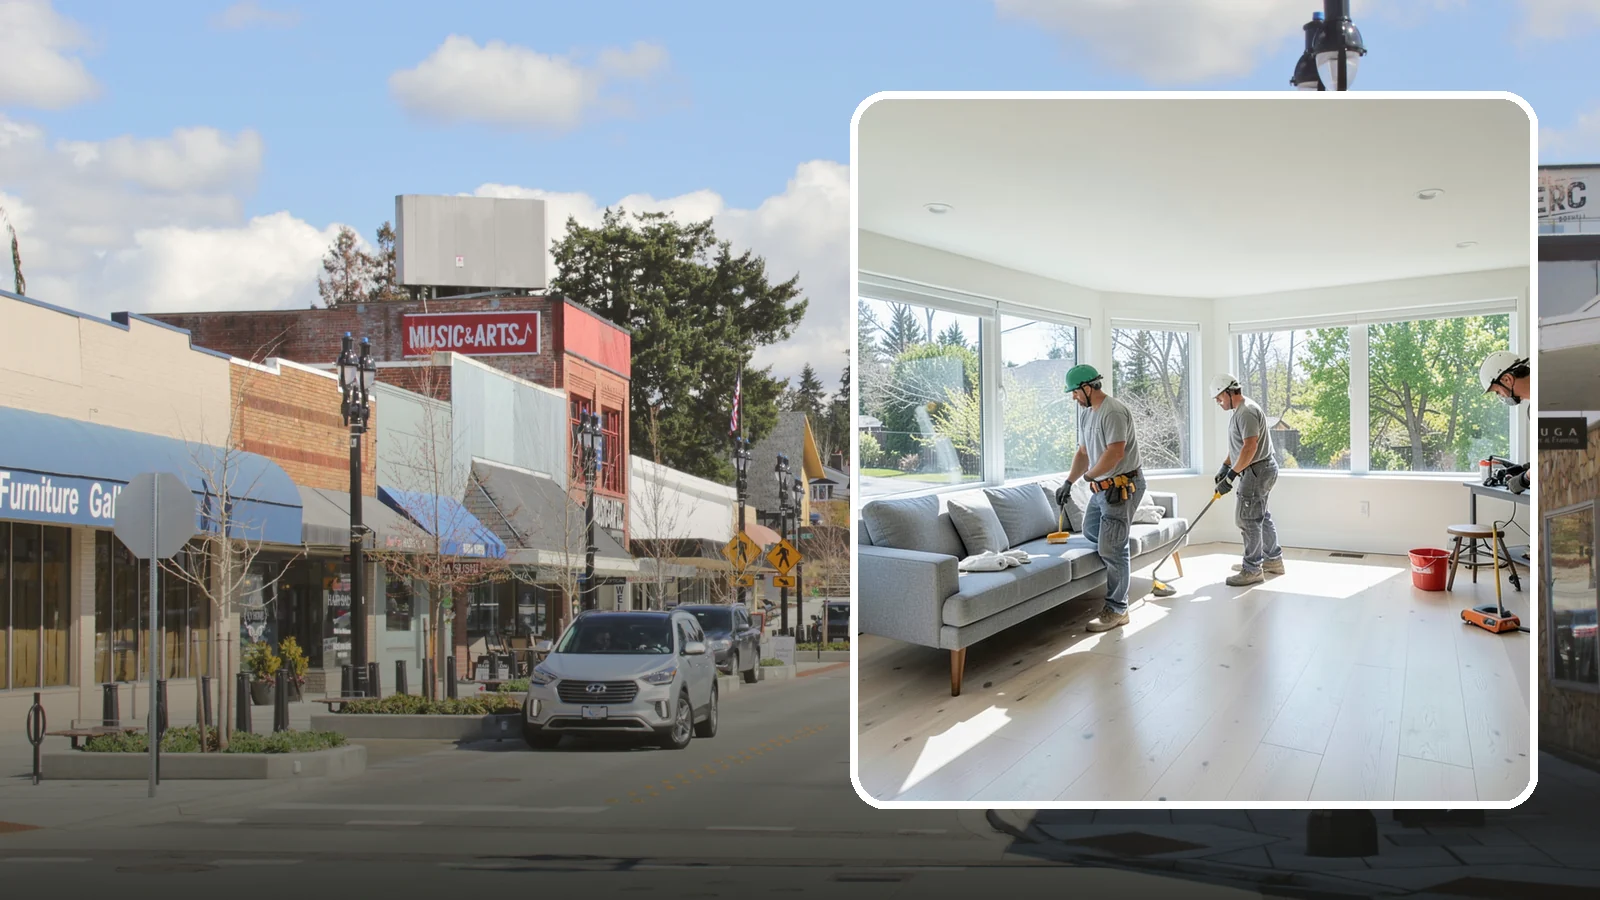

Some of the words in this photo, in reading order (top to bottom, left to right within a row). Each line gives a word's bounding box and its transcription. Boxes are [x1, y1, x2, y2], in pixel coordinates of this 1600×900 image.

[1541, 428, 1577, 436] UGA
[0, 472, 80, 515] Furniture
[90, 483, 121, 519] Gal
[454, 563, 479, 574] SUSHI
